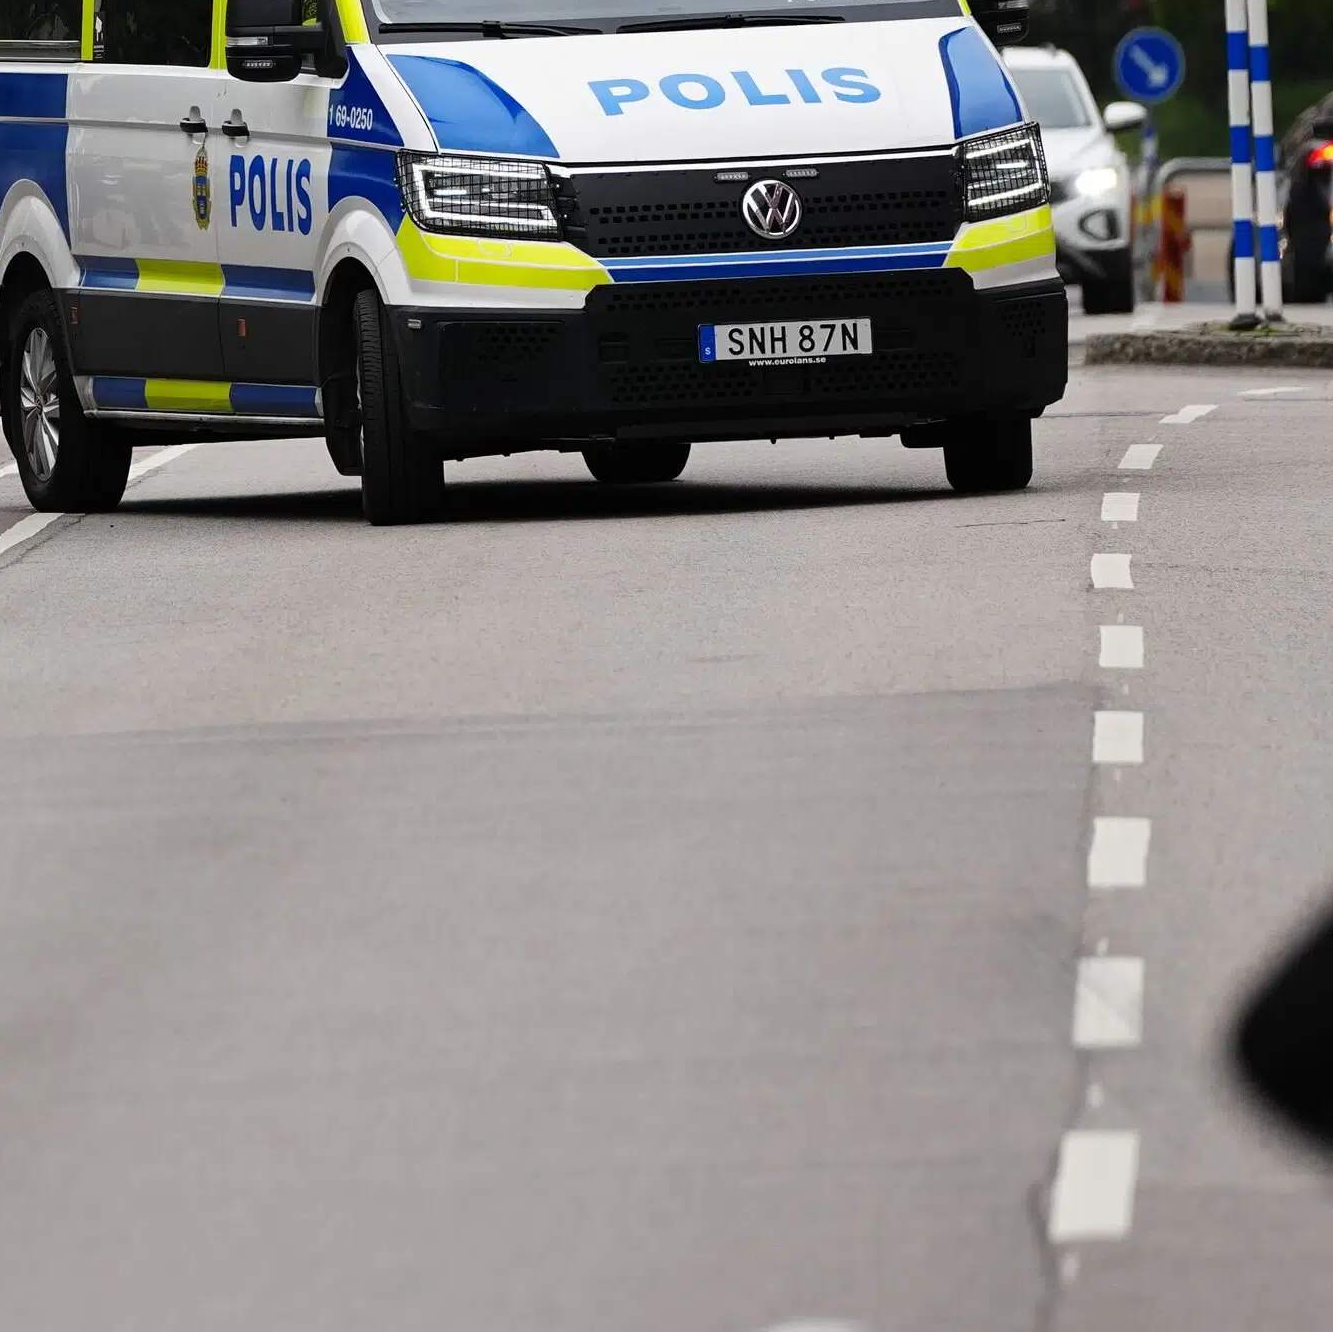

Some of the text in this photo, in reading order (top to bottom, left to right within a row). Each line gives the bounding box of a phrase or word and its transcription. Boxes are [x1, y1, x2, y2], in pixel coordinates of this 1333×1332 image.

[587, 67, 882, 117] POLIS
[328, 104, 373, 131] 1 69-0250
[229, 154, 312, 236] POLIS
[704, 323, 859, 356] S SNH 87N
